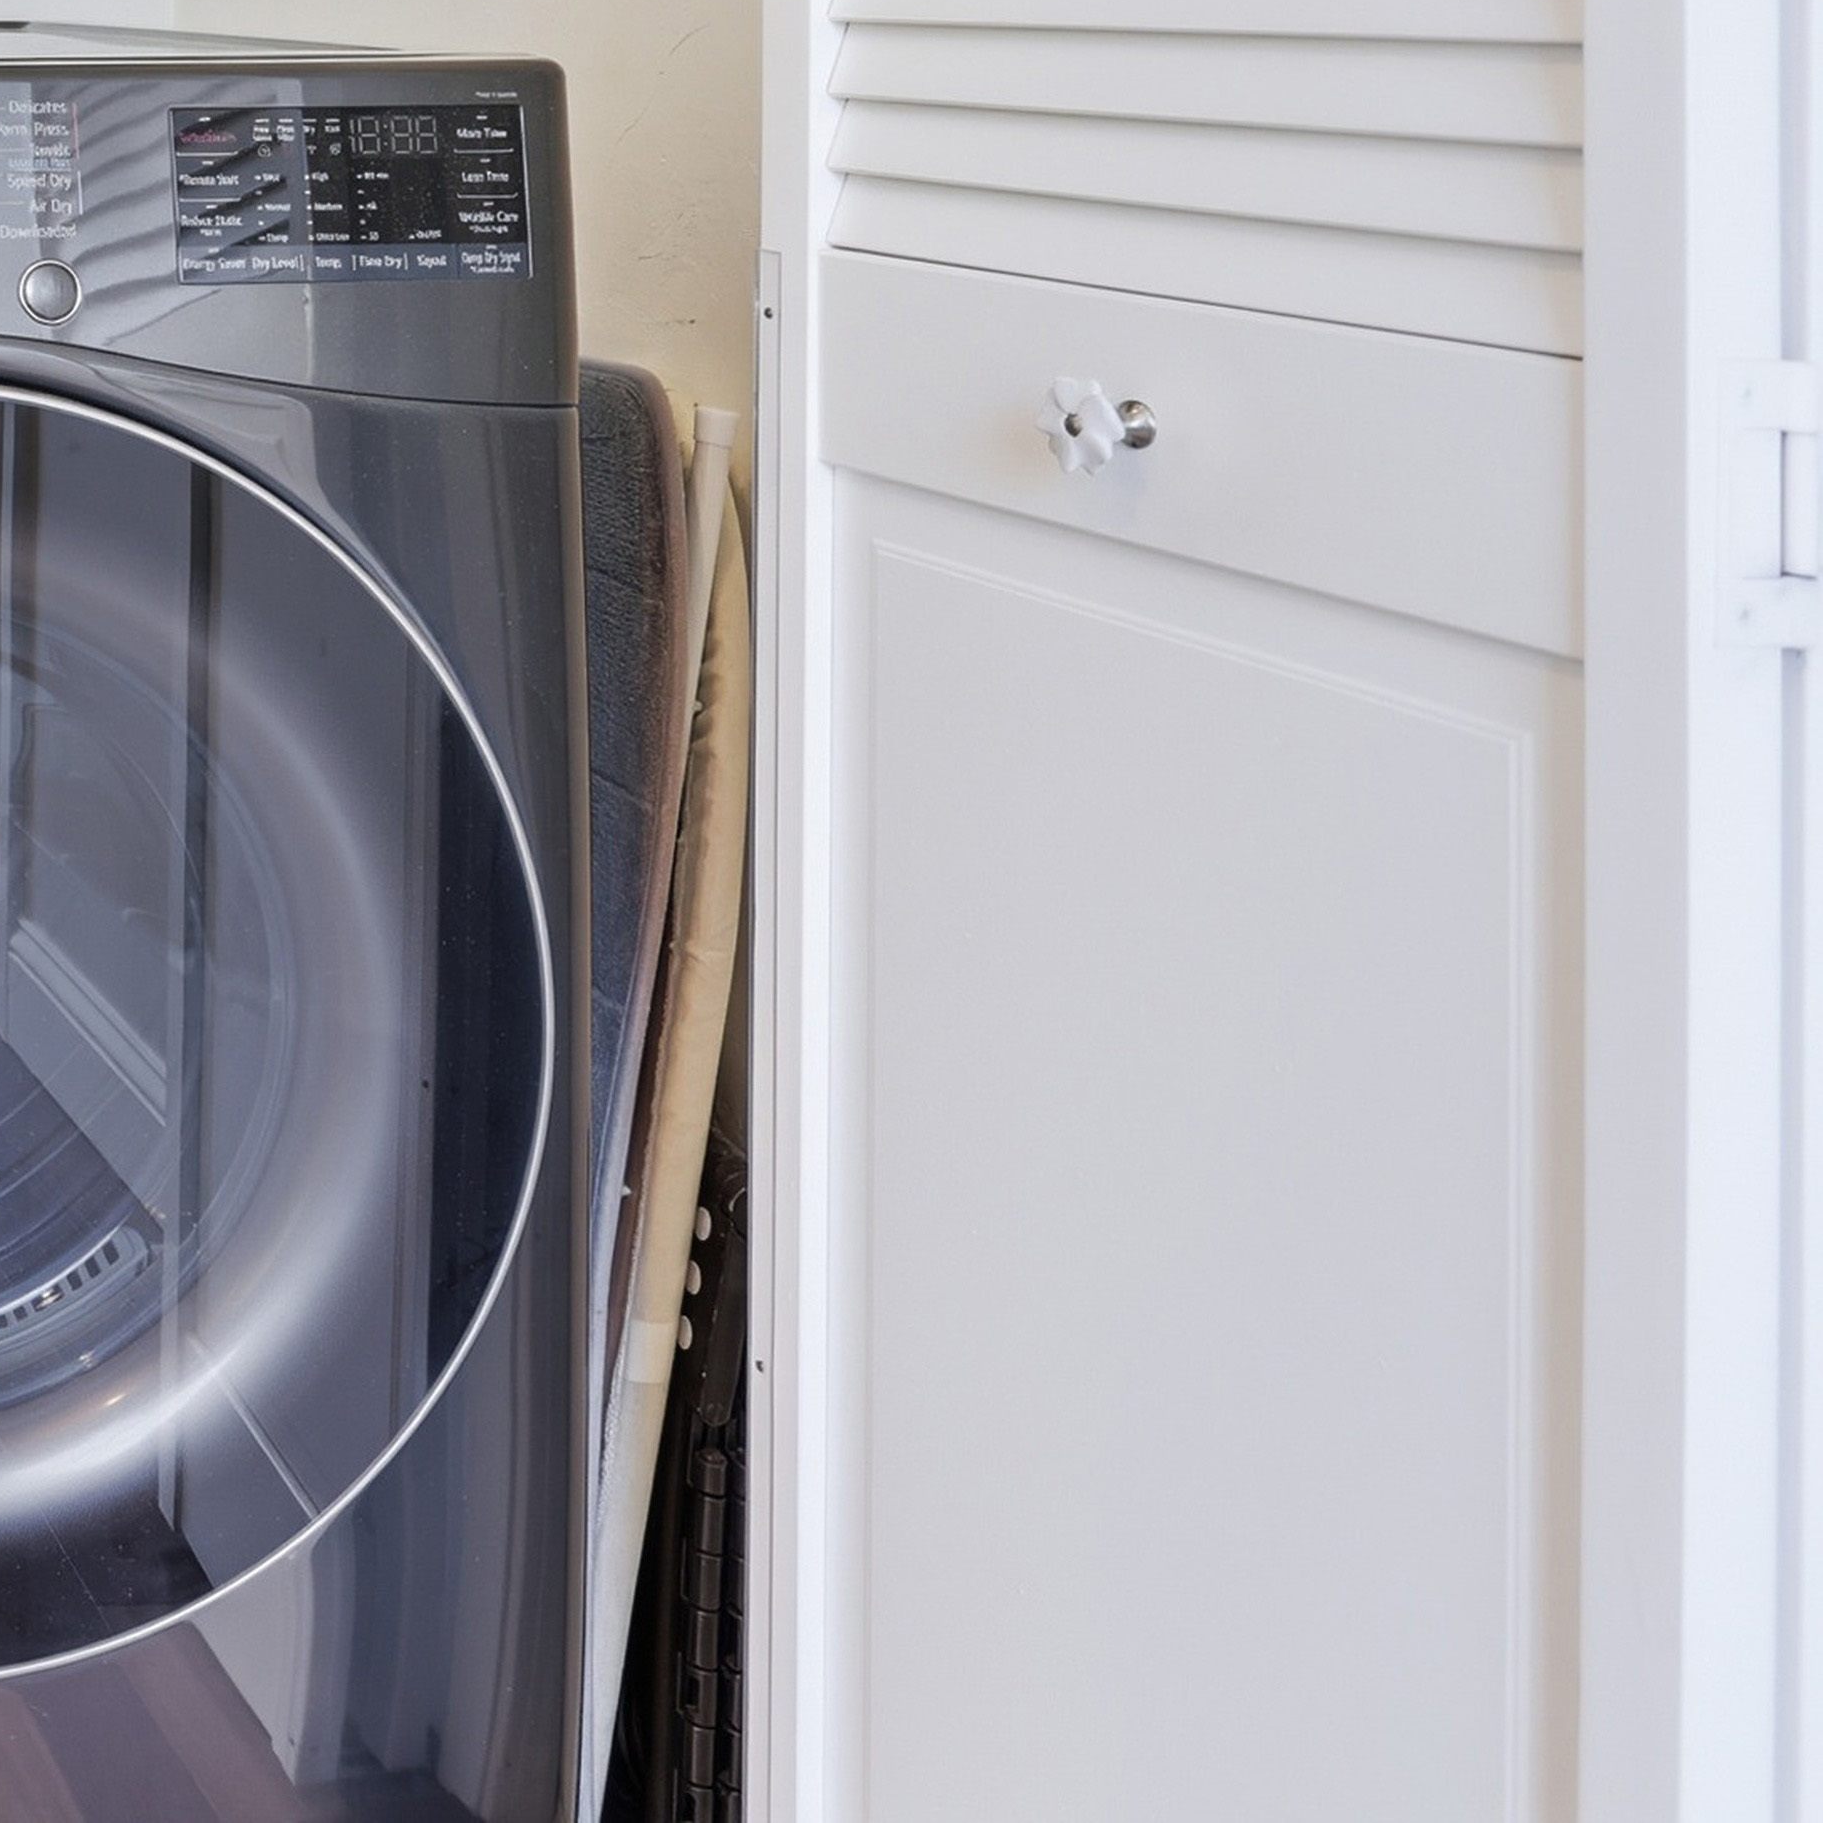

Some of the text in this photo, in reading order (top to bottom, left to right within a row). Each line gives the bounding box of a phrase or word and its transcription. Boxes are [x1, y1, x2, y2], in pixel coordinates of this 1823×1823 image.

[8, 100, 68, 114] Delicates
[7, 172, 72, 191] Speed Dry
[50, 198, 73, 215] Dry
[496, 210, 520, 223] Care
[0, 224, 77, 239] Downloaded
[252, 257, 299, 271] Dry Level
[384, 255, 403, 269] Dry
